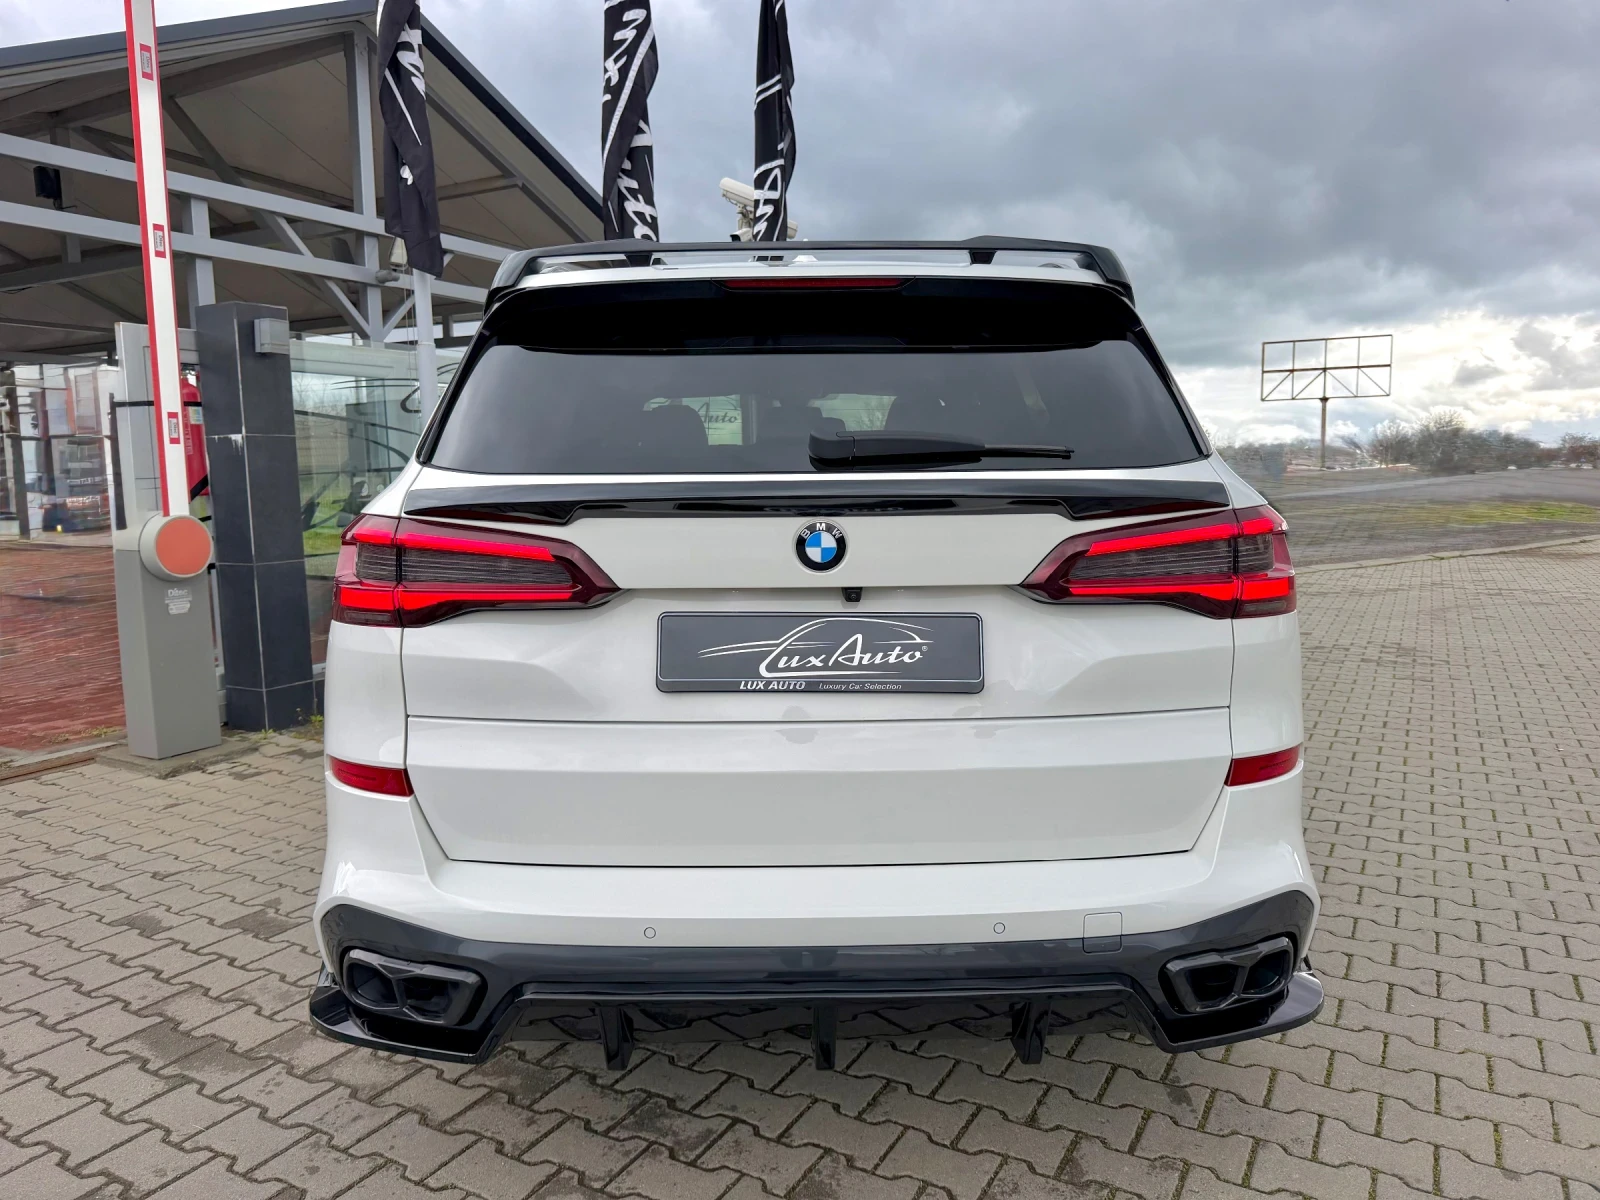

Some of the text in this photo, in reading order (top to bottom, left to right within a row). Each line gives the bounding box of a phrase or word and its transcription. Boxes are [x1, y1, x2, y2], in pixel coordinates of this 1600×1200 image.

[800, 522, 843, 539] BMW
[740, 681, 766, 690] LUX
[768, 681, 806, 690] AUTO
[819, 682, 847, 691] Luxury
